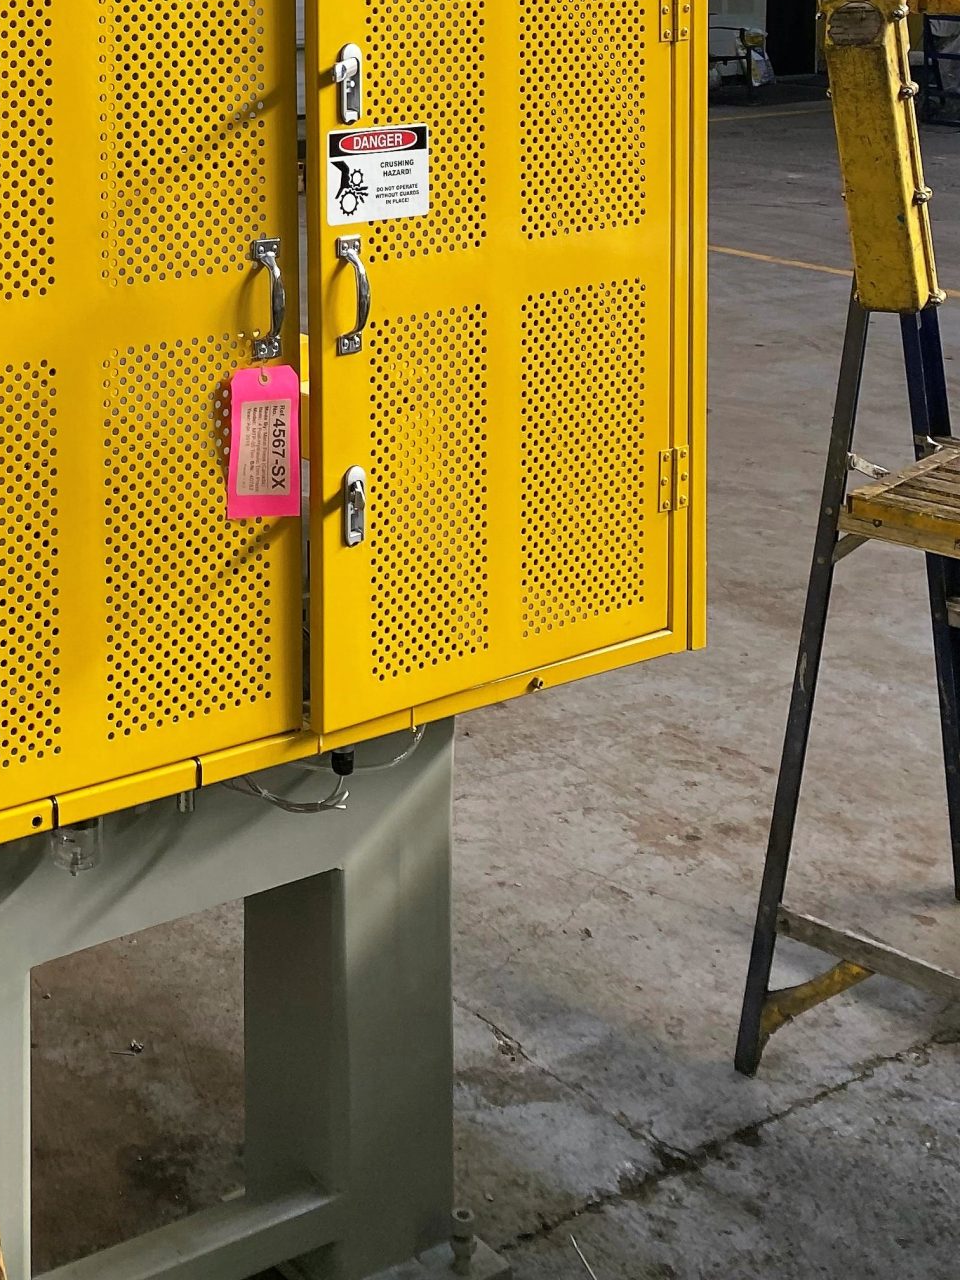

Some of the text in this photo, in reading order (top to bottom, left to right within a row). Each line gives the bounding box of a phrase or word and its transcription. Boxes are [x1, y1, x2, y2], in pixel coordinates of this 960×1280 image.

[353, 133, 403, 149] DANGER
[380, 158, 414, 168] CRUSHING
[383, 168, 412, 177] HAZARD!
[272, 419, 285, 489] 4567-SX
